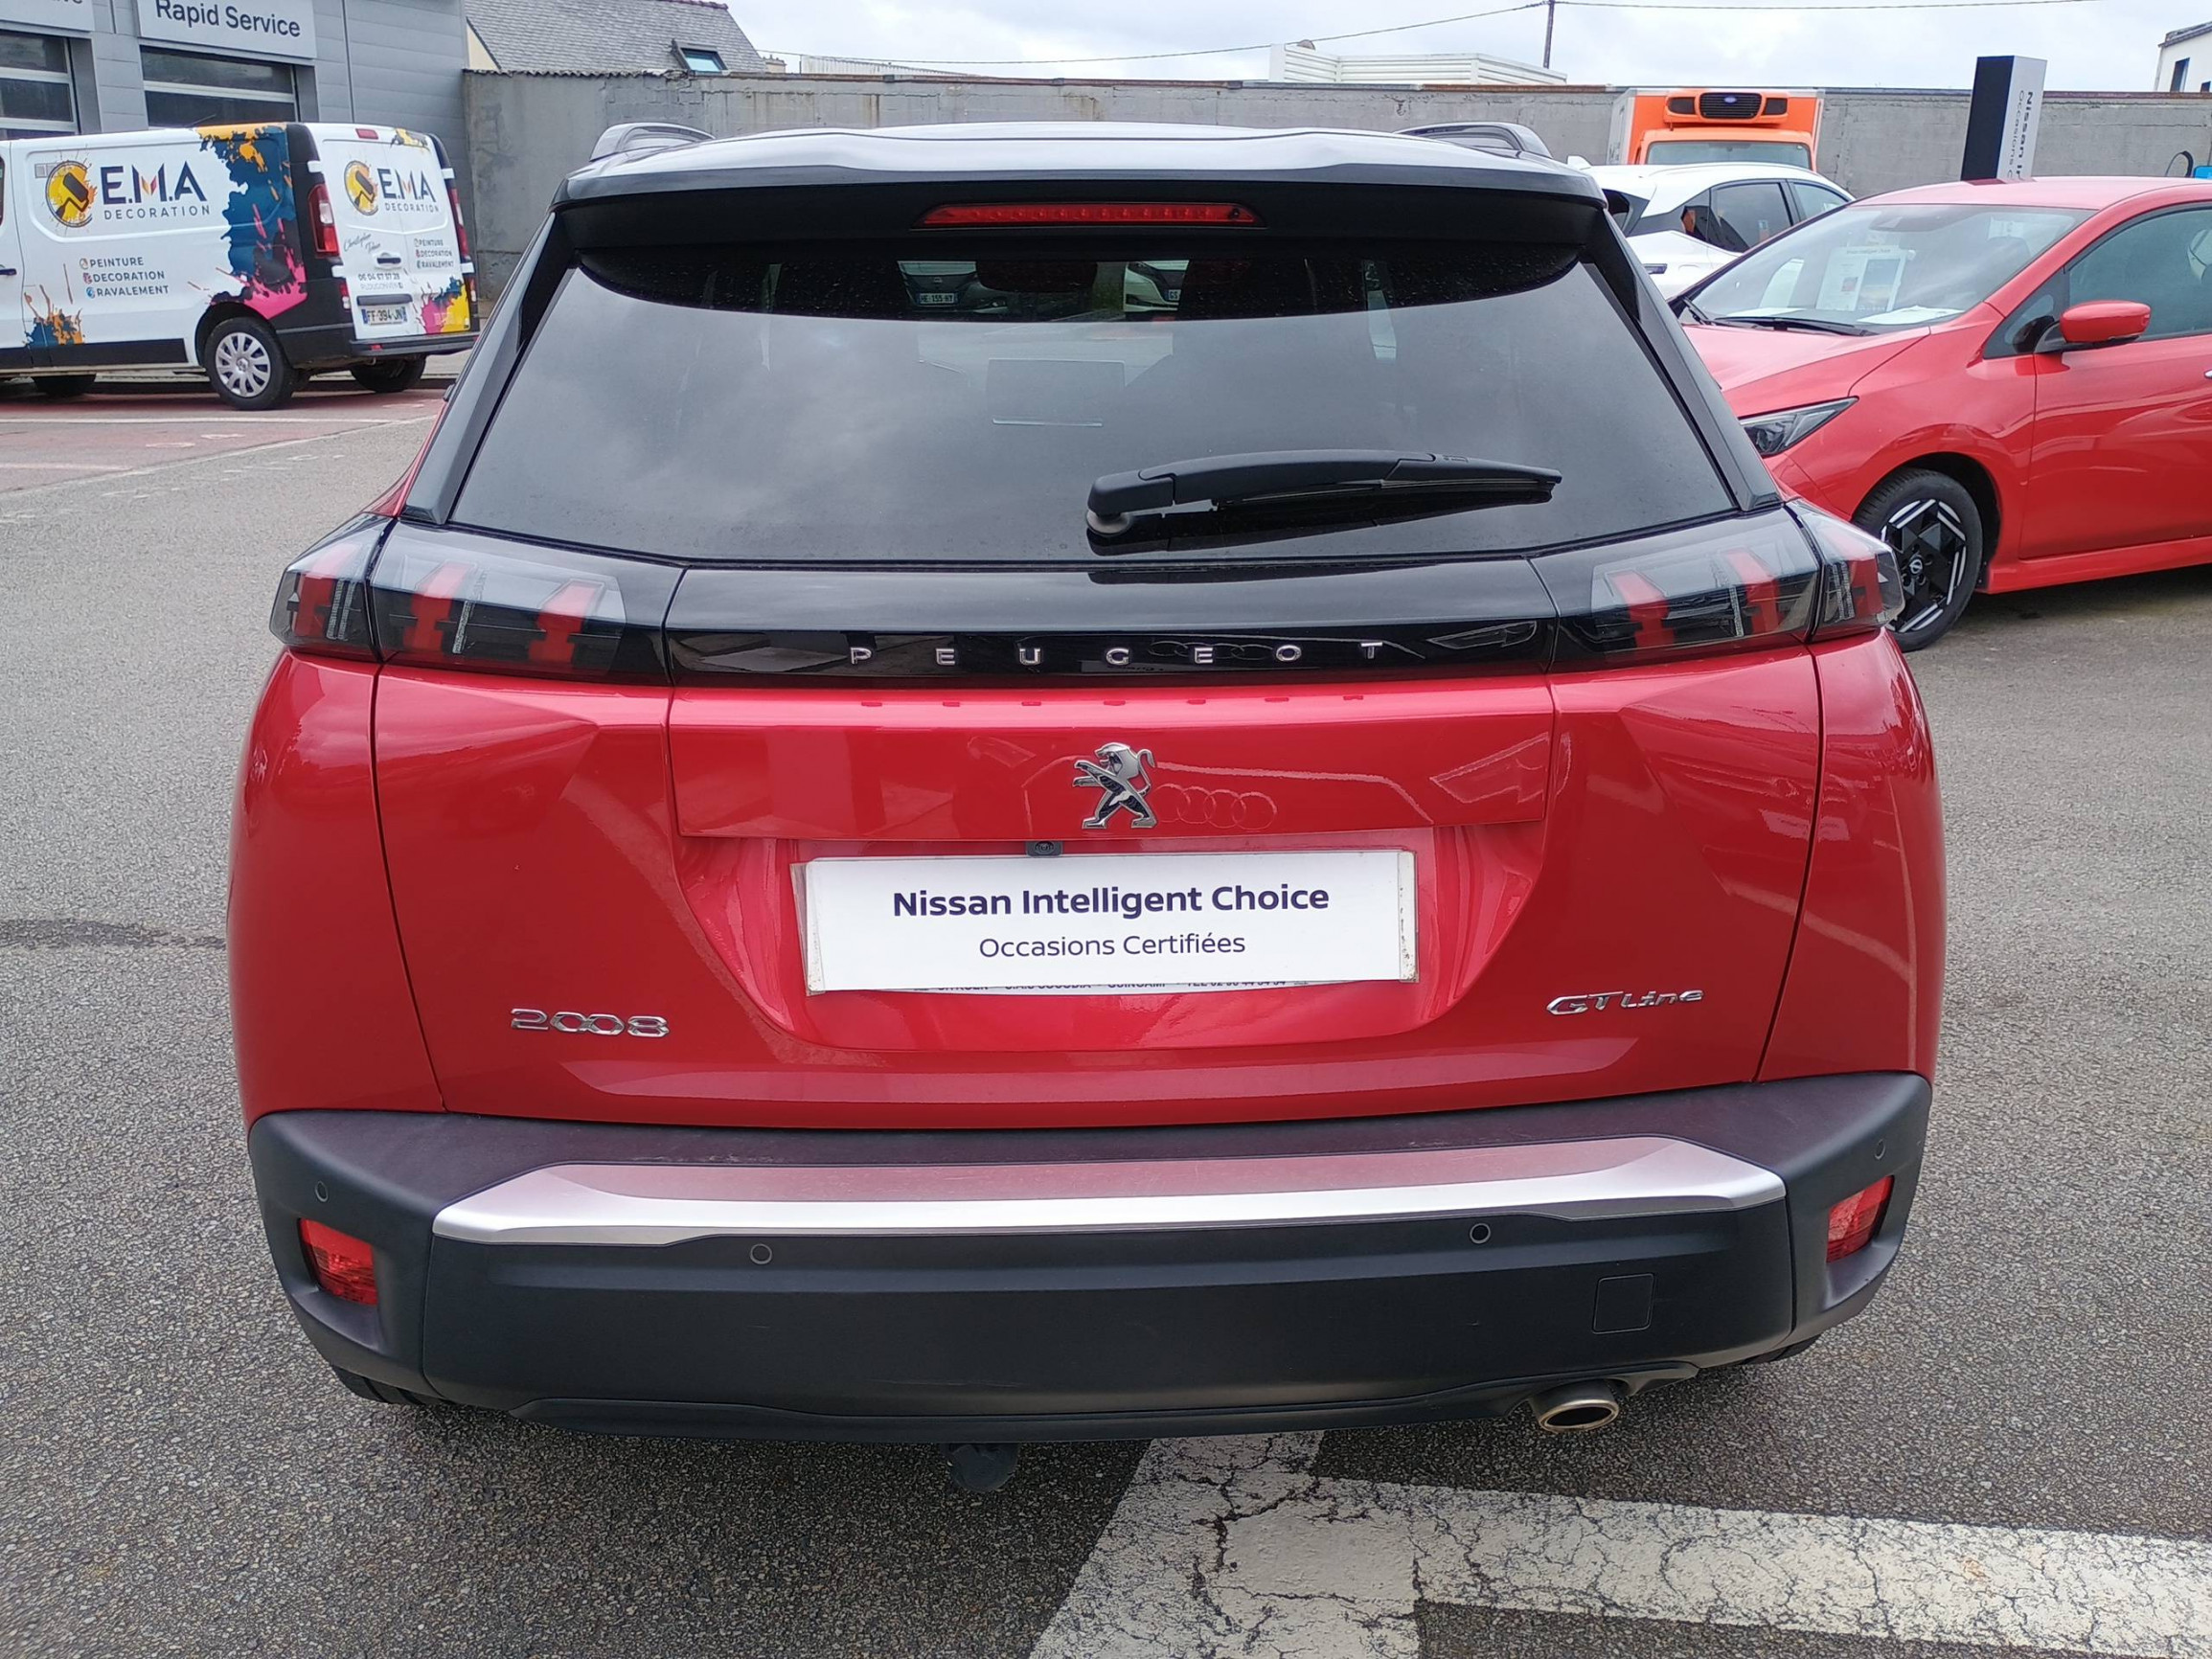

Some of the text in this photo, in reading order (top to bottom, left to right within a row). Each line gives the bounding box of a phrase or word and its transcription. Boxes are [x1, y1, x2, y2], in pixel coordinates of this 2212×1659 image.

[155, 0, 302, 37] Rapid Service
[2018, 92, 2033, 158] Nissan
[103, 205, 211, 220] DECORATION
[384, 202, 440, 213] DECORATION
[89, 257, 145, 268] PEINTURE
[93, 270, 166, 283] DECORATION
[97, 284, 170, 298] RAVALEMENT
[849, 641, 1384, 667] PEUGEOT
[893, 883, 1330, 920] Nissan Intelligent Choice
[979, 932, 1246, 958] Occasions Certifiées
[510, 1008, 671, 1039] 2008
